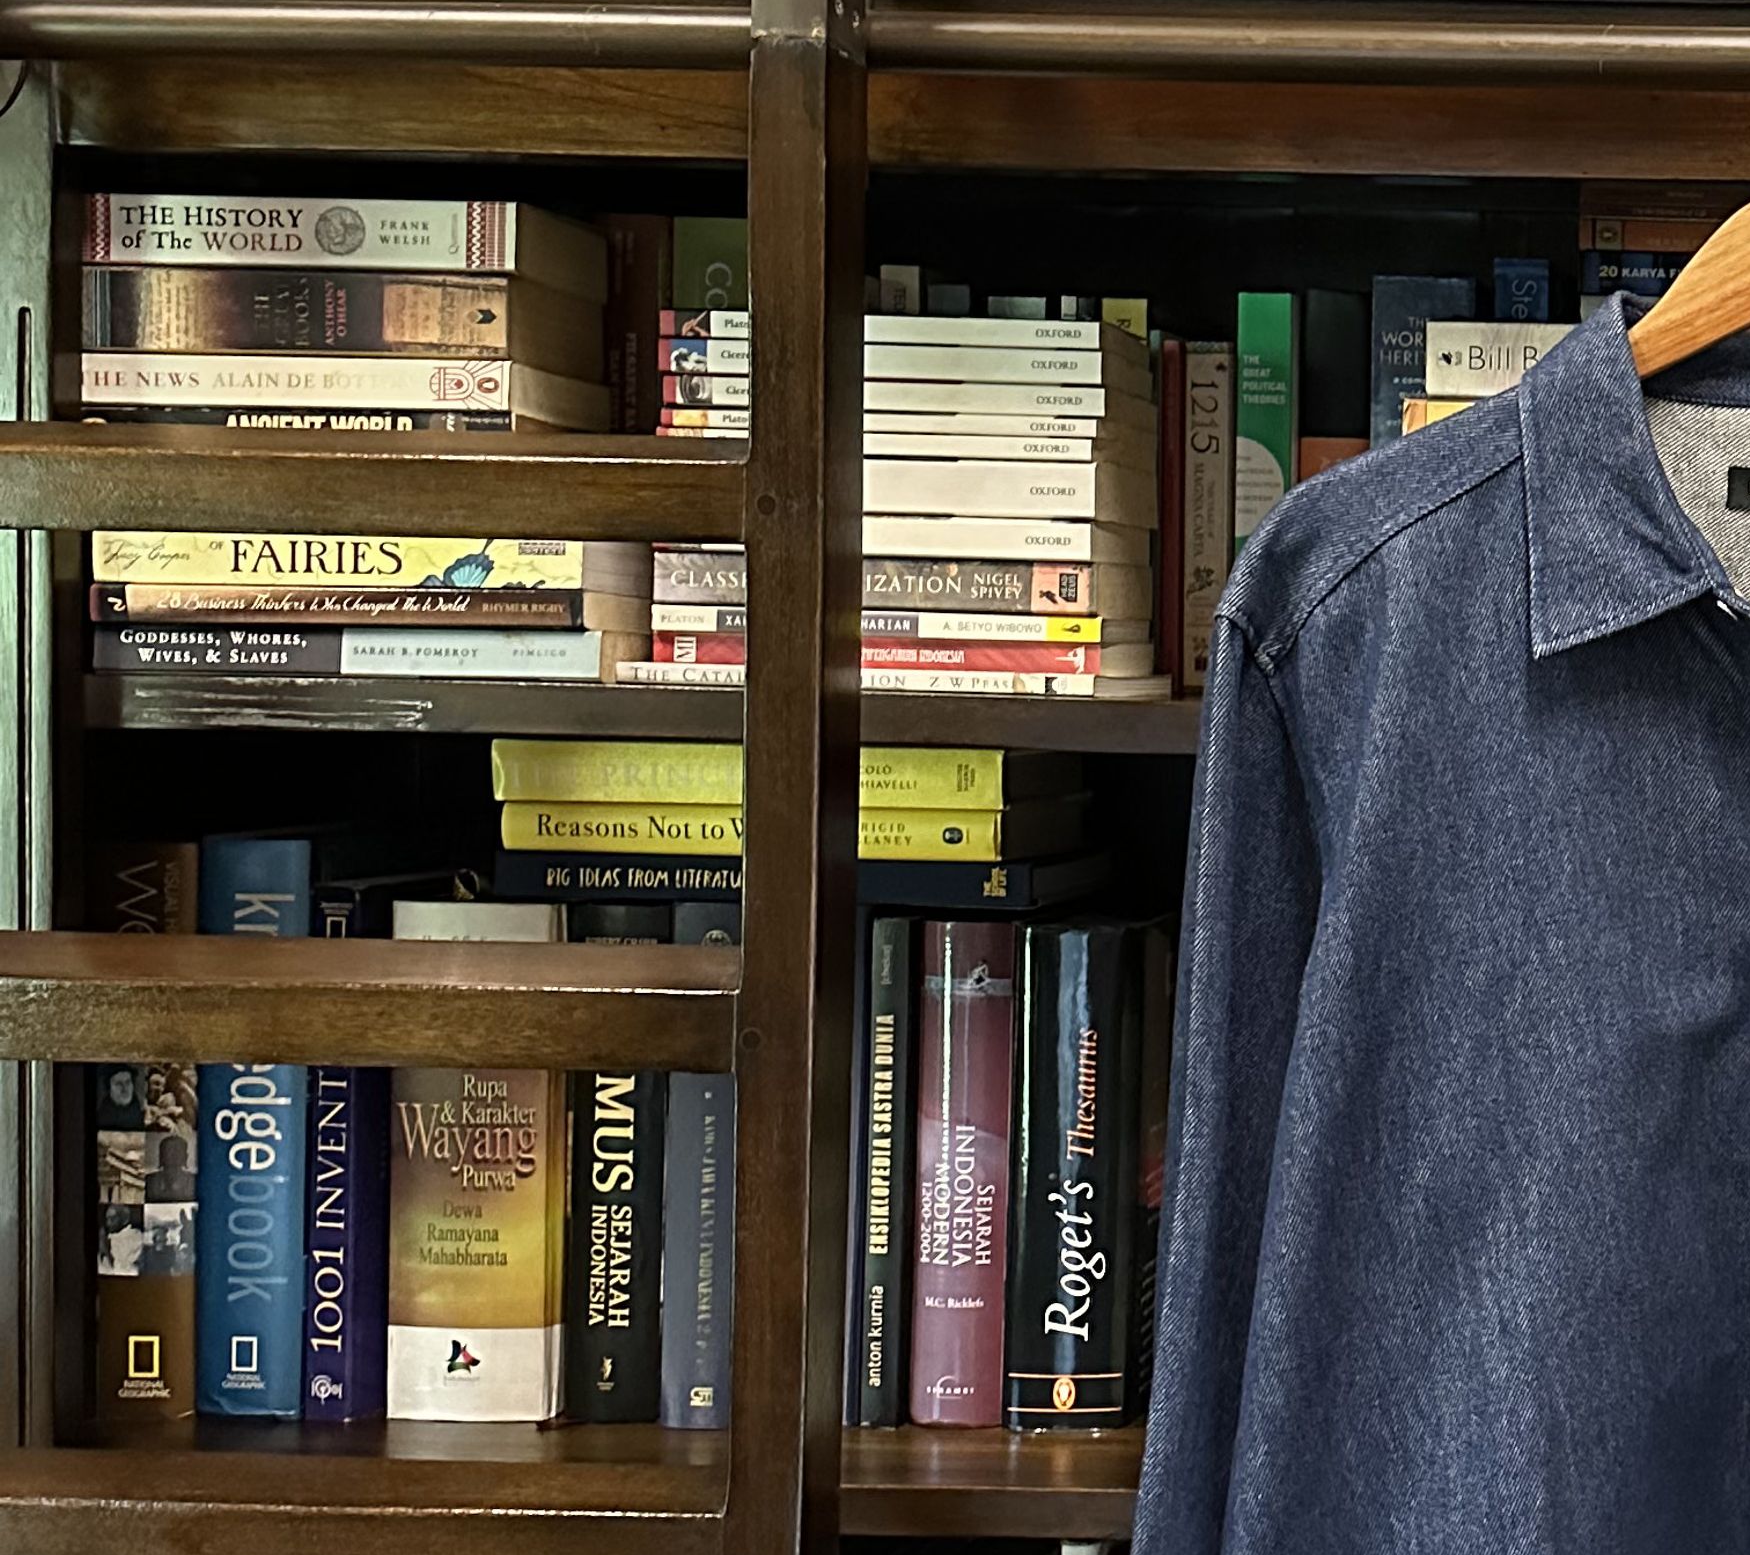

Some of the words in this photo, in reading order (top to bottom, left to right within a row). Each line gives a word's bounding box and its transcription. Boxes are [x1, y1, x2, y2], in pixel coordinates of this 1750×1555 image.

[119, 206, 175, 227] THE
[184, 206, 303, 229] HISTORY
[380, 219, 430, 231] FRANK
[121, 230, 145, 249] of
[151, 231, 192, 250] The
[203, 232, 304, 253] WORLD
[379, 234, 431, 245] WELSH
[1035, 328, 1082, 340] OXFORD
[1190, 378, 1221, 456] 1215
[230, 539, 403, 576] FAIRIES
[119, 630, 221, 647] GODDESSES,
[230, 630, 307, 648] WHORES,
[138, 648, 197, 666] WIVES,
[206, 647, 222, 664] &
[229, 648, 288, 664] SLAVES
[536, 813, 639, 840] Reasons
[647, 814, 694, 840] Not
[700, 817, 724, 841] to
[462, 1075, 508, 1102] Rupa
[1067, 1027, 1098, 1159] Thesaurus
[440, 1102, 456, 1124] &
[460, 1103, 536, 1125] Karakter
[399, 1101, 538, 1178] Wayang
[462, 1165, 516, 1190] Purwa
[588, 1204, 608, 1327] INDONESIA
[610, 1204, 632, 1328] SEJARAH
[1045, 1178, 1107, 1342] Roget's
